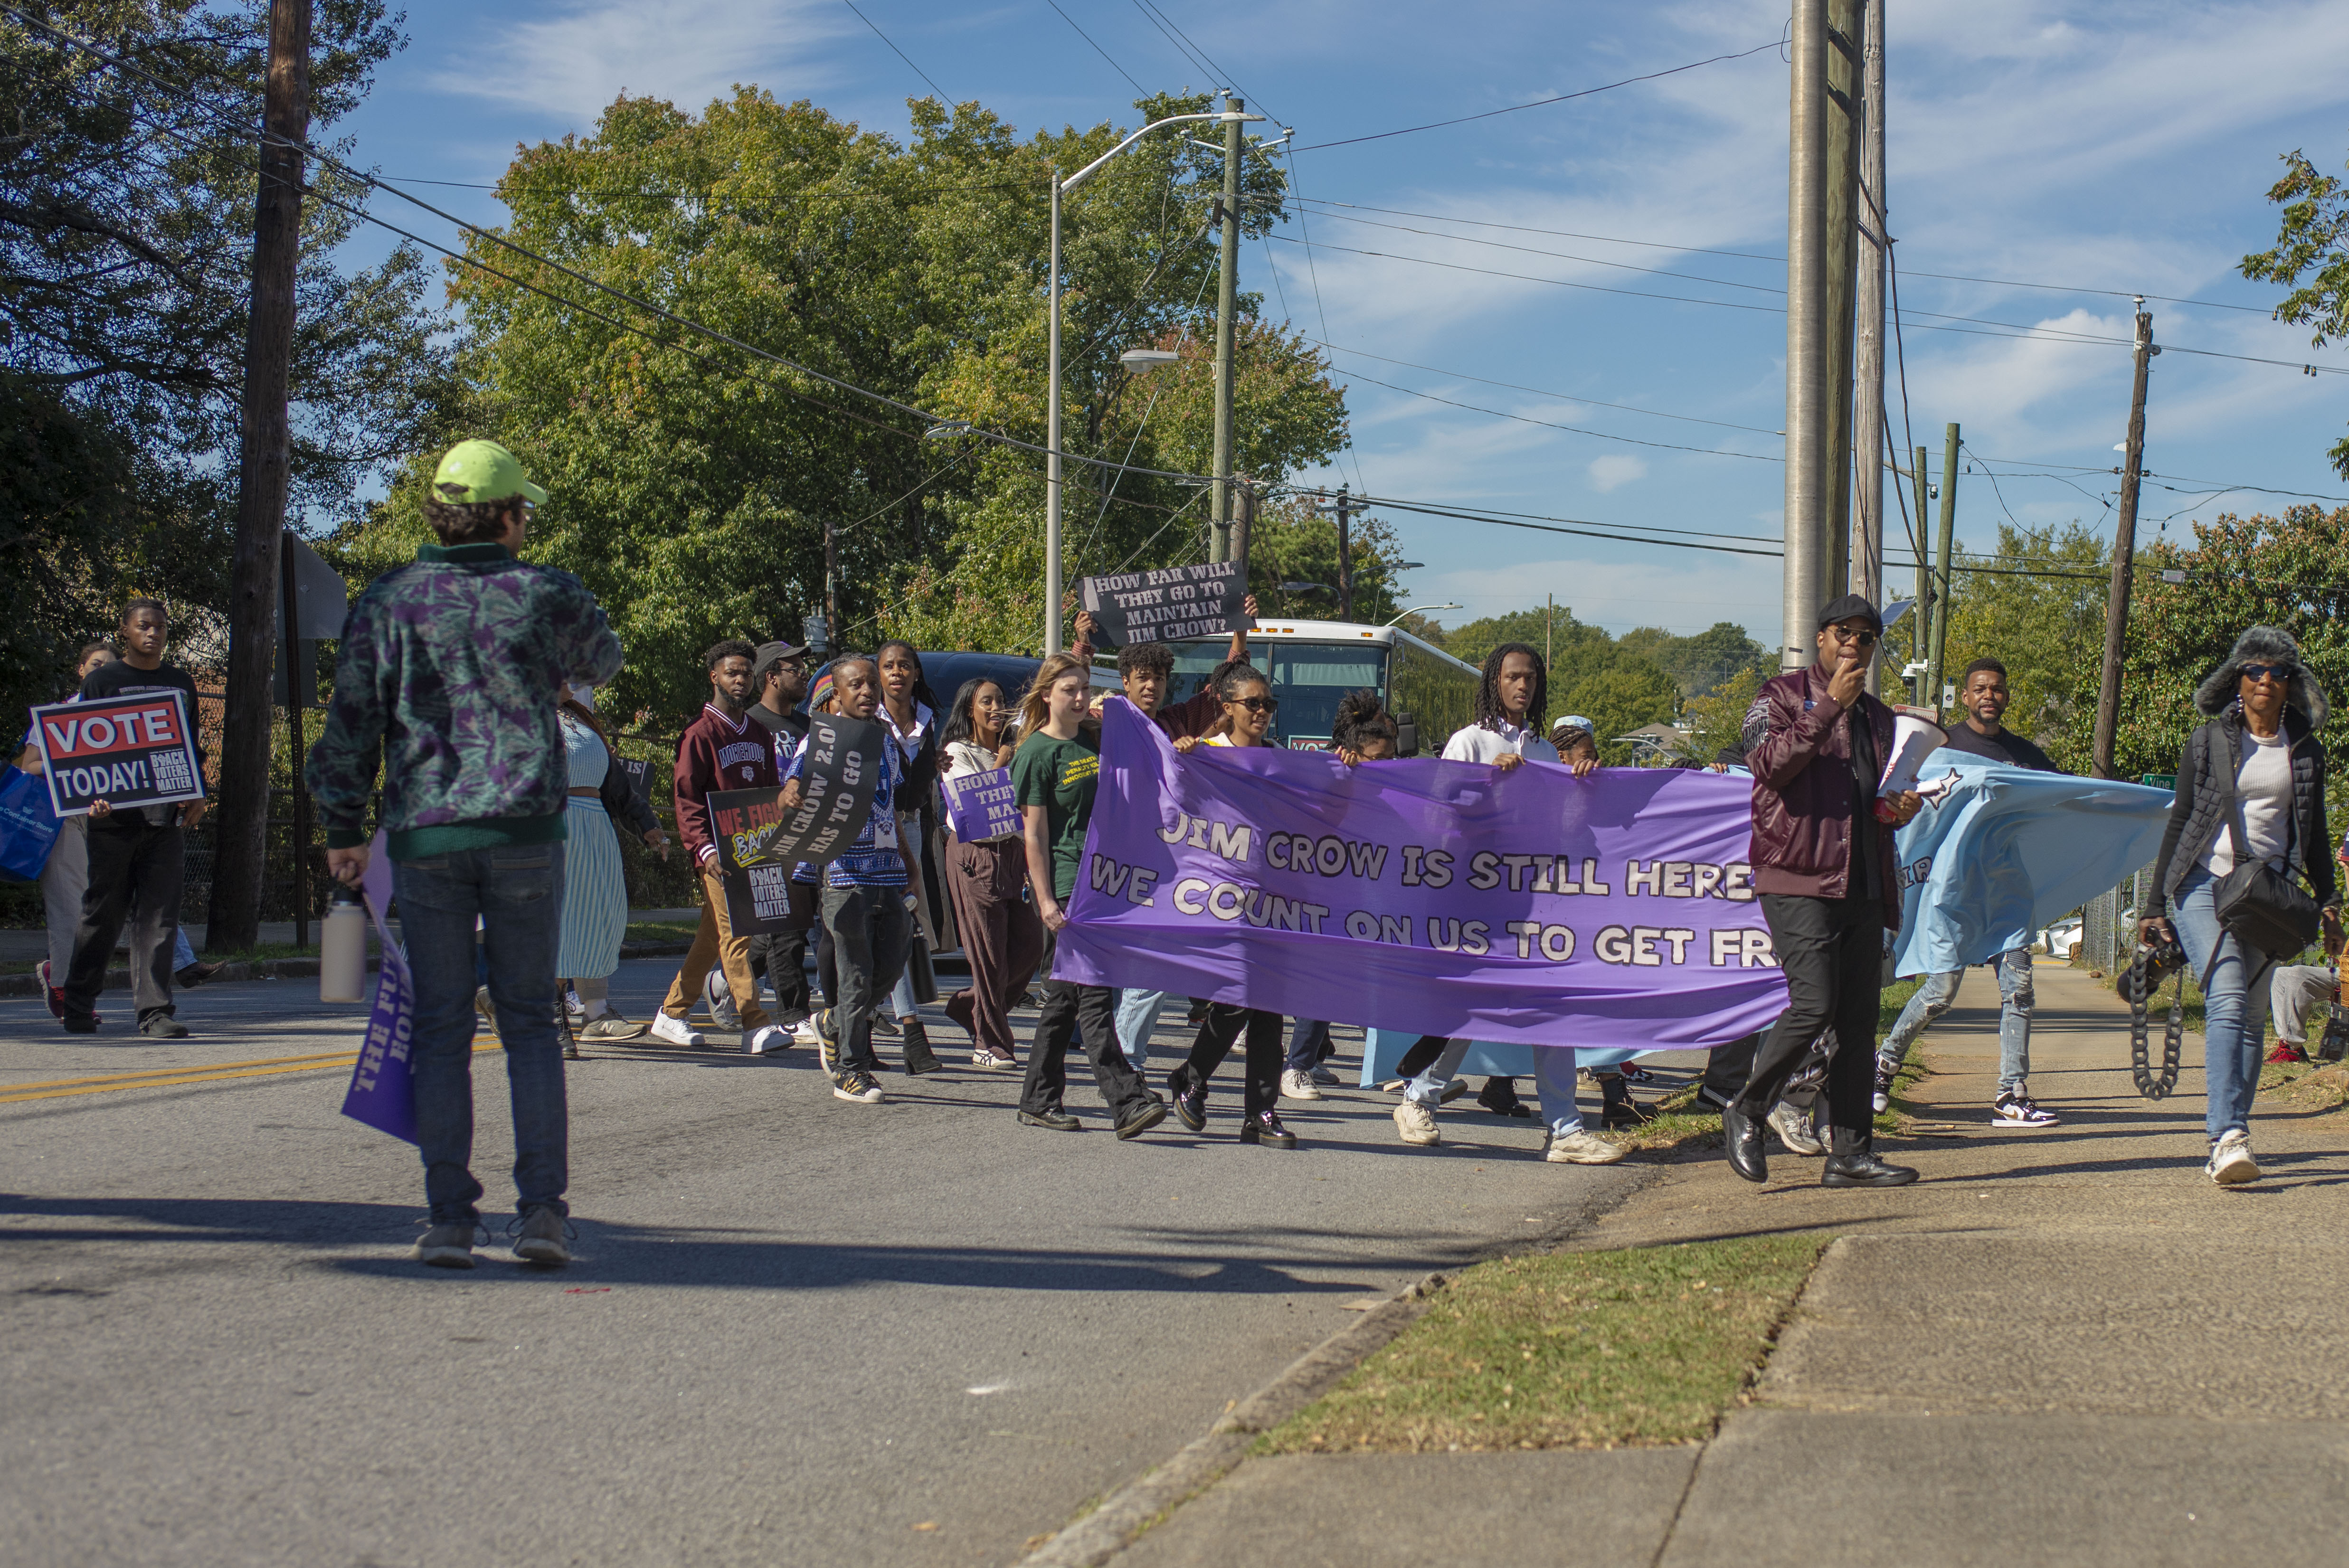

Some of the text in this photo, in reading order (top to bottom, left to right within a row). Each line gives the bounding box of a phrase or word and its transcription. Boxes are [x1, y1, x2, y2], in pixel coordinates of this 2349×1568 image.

[1094, 562, 1235, 593] HOW FAR WILL
[1114, 581, 1225, 608] THEY GO TO
[1126, 600, 1222, 626] MAINTAIN
[1127, 618, 1226, 643] JIM CROW?
[46, 709, 174, 753] VOTE
[719, 742, 766, 769] MOREHOU
[1293, 742, 1328, 751] VO
[153, 764, 190, 779] VOTERS
[627, 761, 643, 774] IS
[1079, 756, 1097, 764] DEATH
[56, 761, 150, 798] TODAY!
[156, 776, 193, 792] MATTER
[956, 771, 998, 793] HOW
[2150, 777, 2170, 789] Vine
[790, 772, 828, 833] CROW
[807, 751, 862, 853] HAS TO GO
[4, 808, 37, 826] Container
[36, 822, 53, 832] Store
[715, 802, 785, 836] WE FIGH
[989, 819, 1018, 836] JIM
[1156, 812, 1756, 902] JIM CROW IS STILL HERE
[751, 883, 788, 902] VOTERS
[754, 899, 790, 918] MATTER
[1090, 853, 1783, 968] WE COUNT ON US TO GET FR
[354, 1022, 390, 1092] THE
